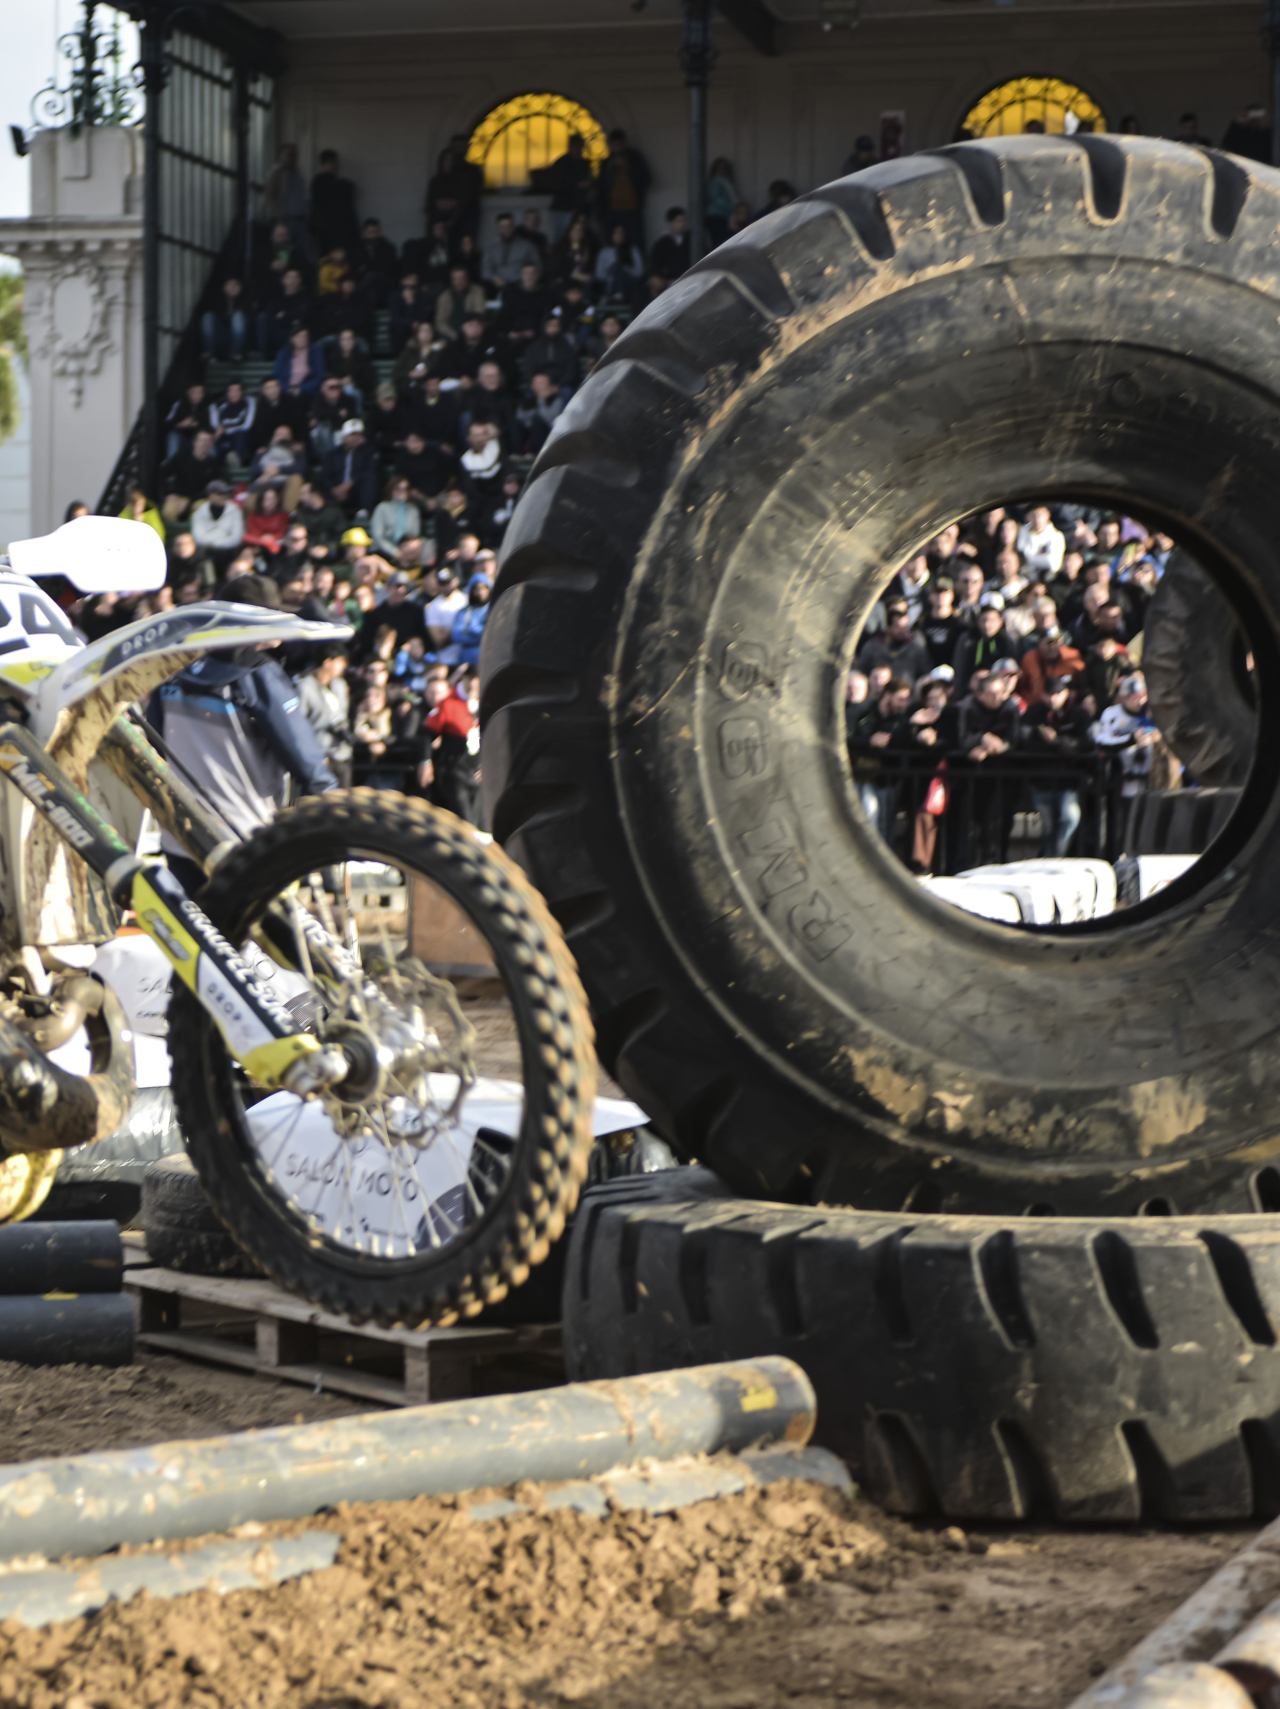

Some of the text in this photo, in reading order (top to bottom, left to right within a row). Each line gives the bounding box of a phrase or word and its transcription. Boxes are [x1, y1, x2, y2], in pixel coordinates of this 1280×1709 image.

[121, 621, 170, 656] DROP
[180, 899, 254, 983] GRAUPEL
[206, 982, 243, 1022] DROP
[356, 1168, 419, 1202] MOTO
